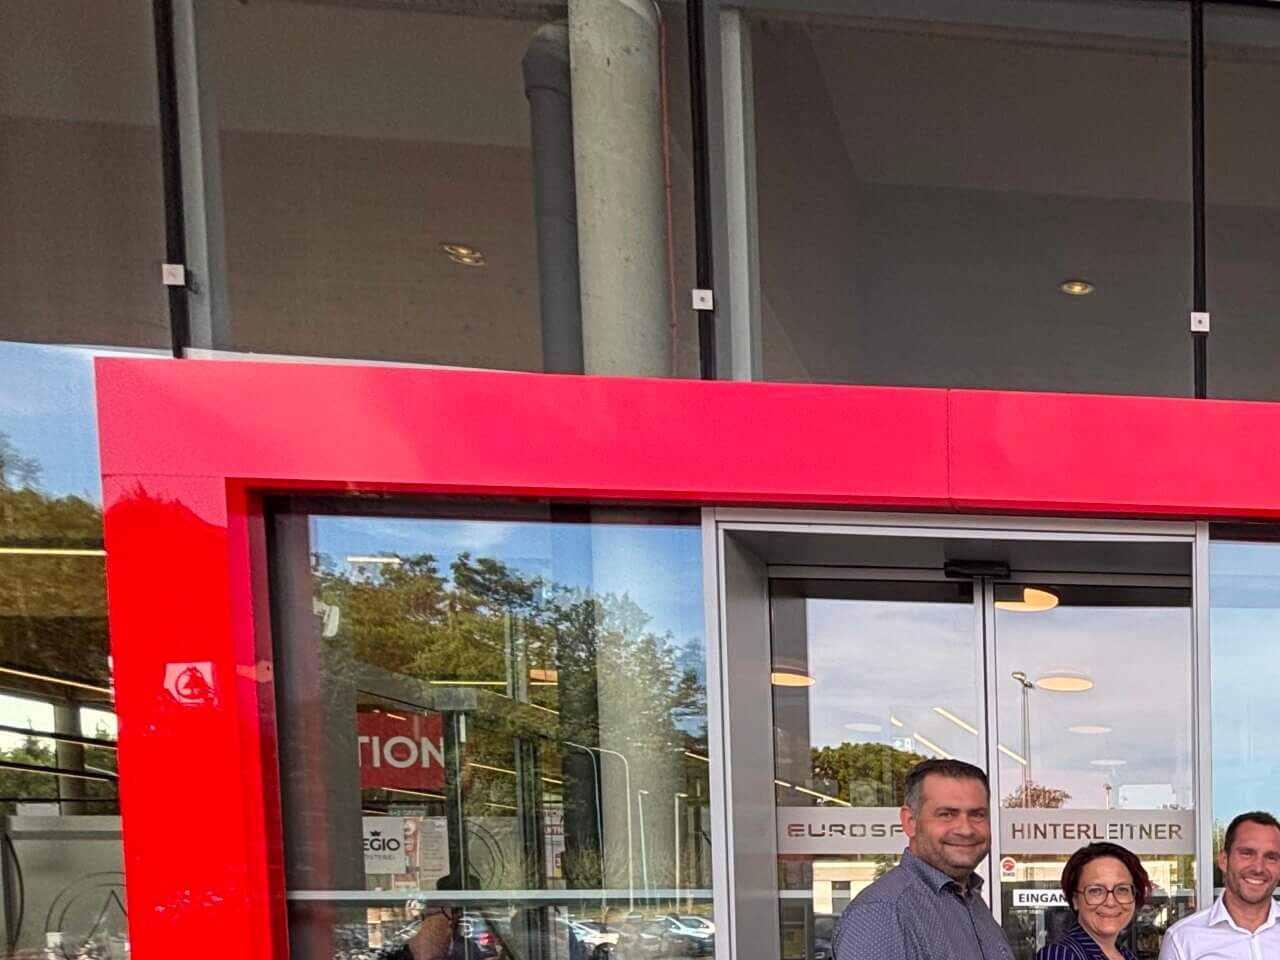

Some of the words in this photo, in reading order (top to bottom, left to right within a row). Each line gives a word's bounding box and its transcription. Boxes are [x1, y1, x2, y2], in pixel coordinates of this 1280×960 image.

[358, 735, 445, 769] TION
[786, 823, 904, 837] EUROSP
[1011, 823, 1184, 840] HINTERLEITNER
[362, 837, 401, 851] EGIO
[1018, 893, 1067, 903] EINGAN
